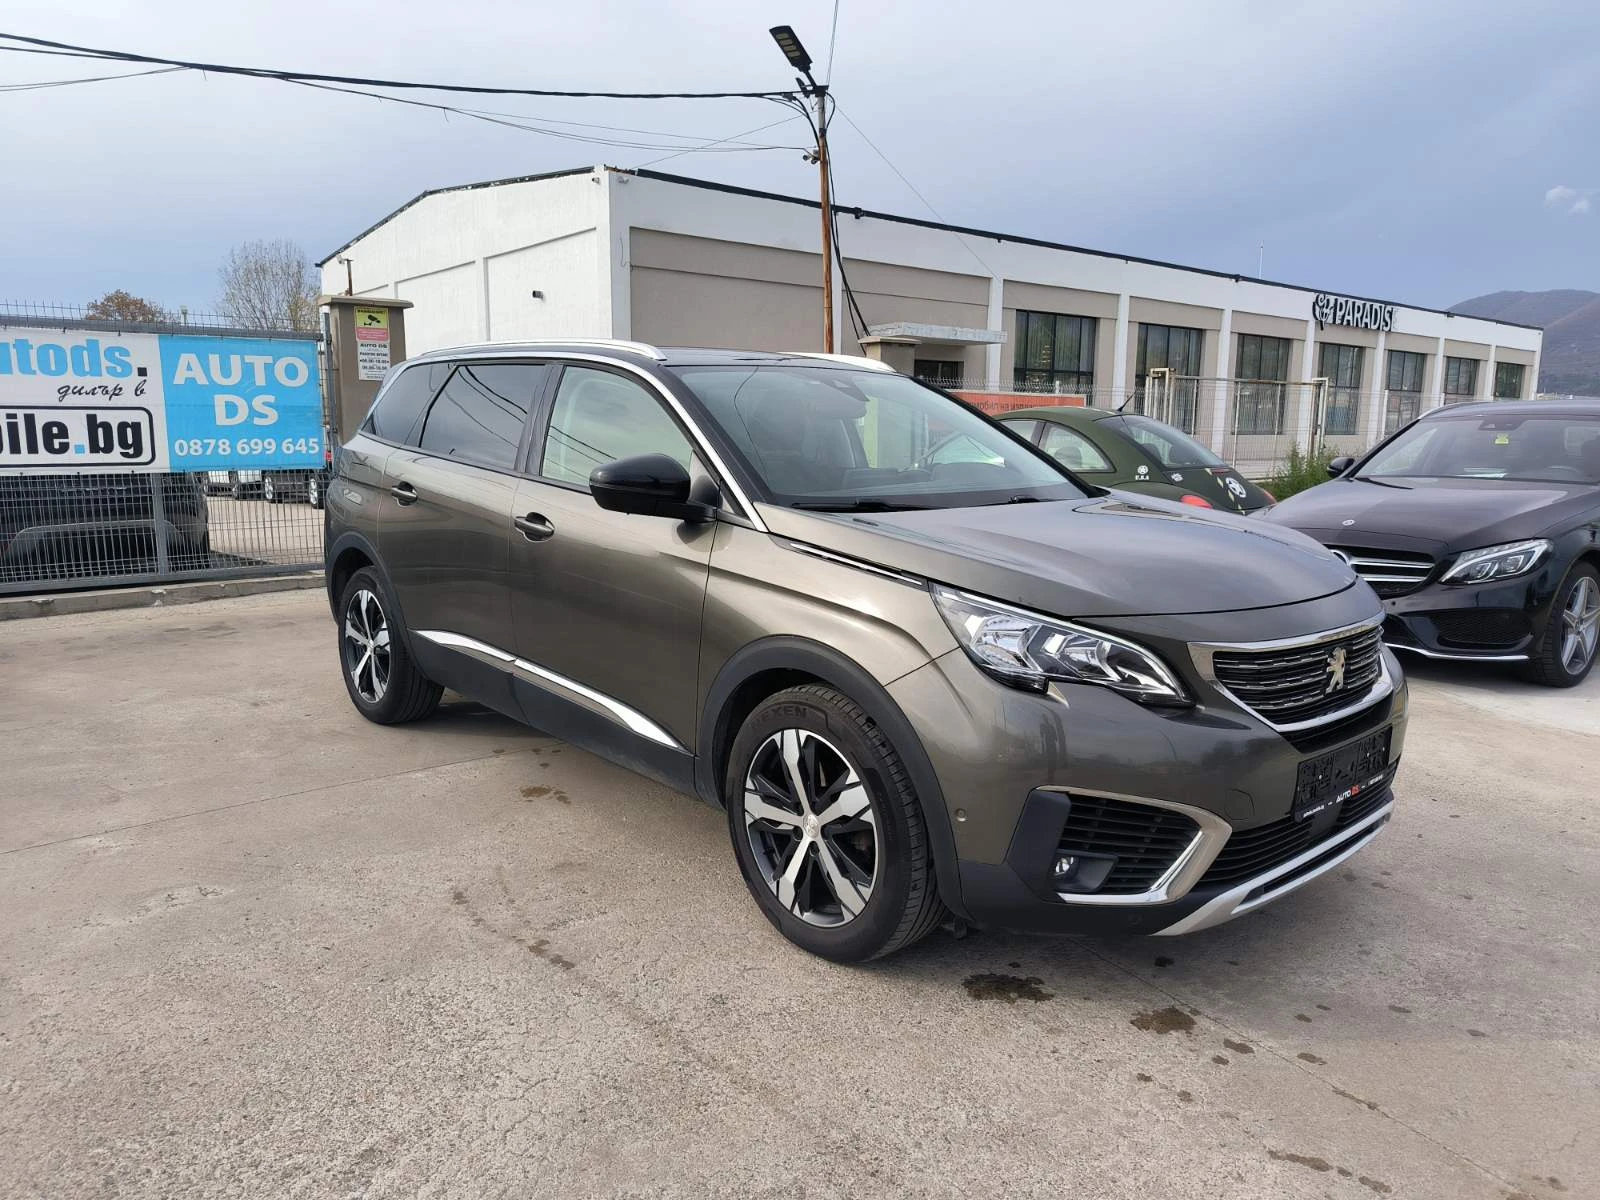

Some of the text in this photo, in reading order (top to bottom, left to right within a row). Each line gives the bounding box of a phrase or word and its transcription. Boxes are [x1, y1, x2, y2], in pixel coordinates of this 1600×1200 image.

[173, 353, 309, 388] AUTO
[57, 383, 124, 402] дилър
[214, 394, 279, 426] DS
[0, 413, 144, 459] ile.bg
[174, 437, 320, 456] 0878 699 645
